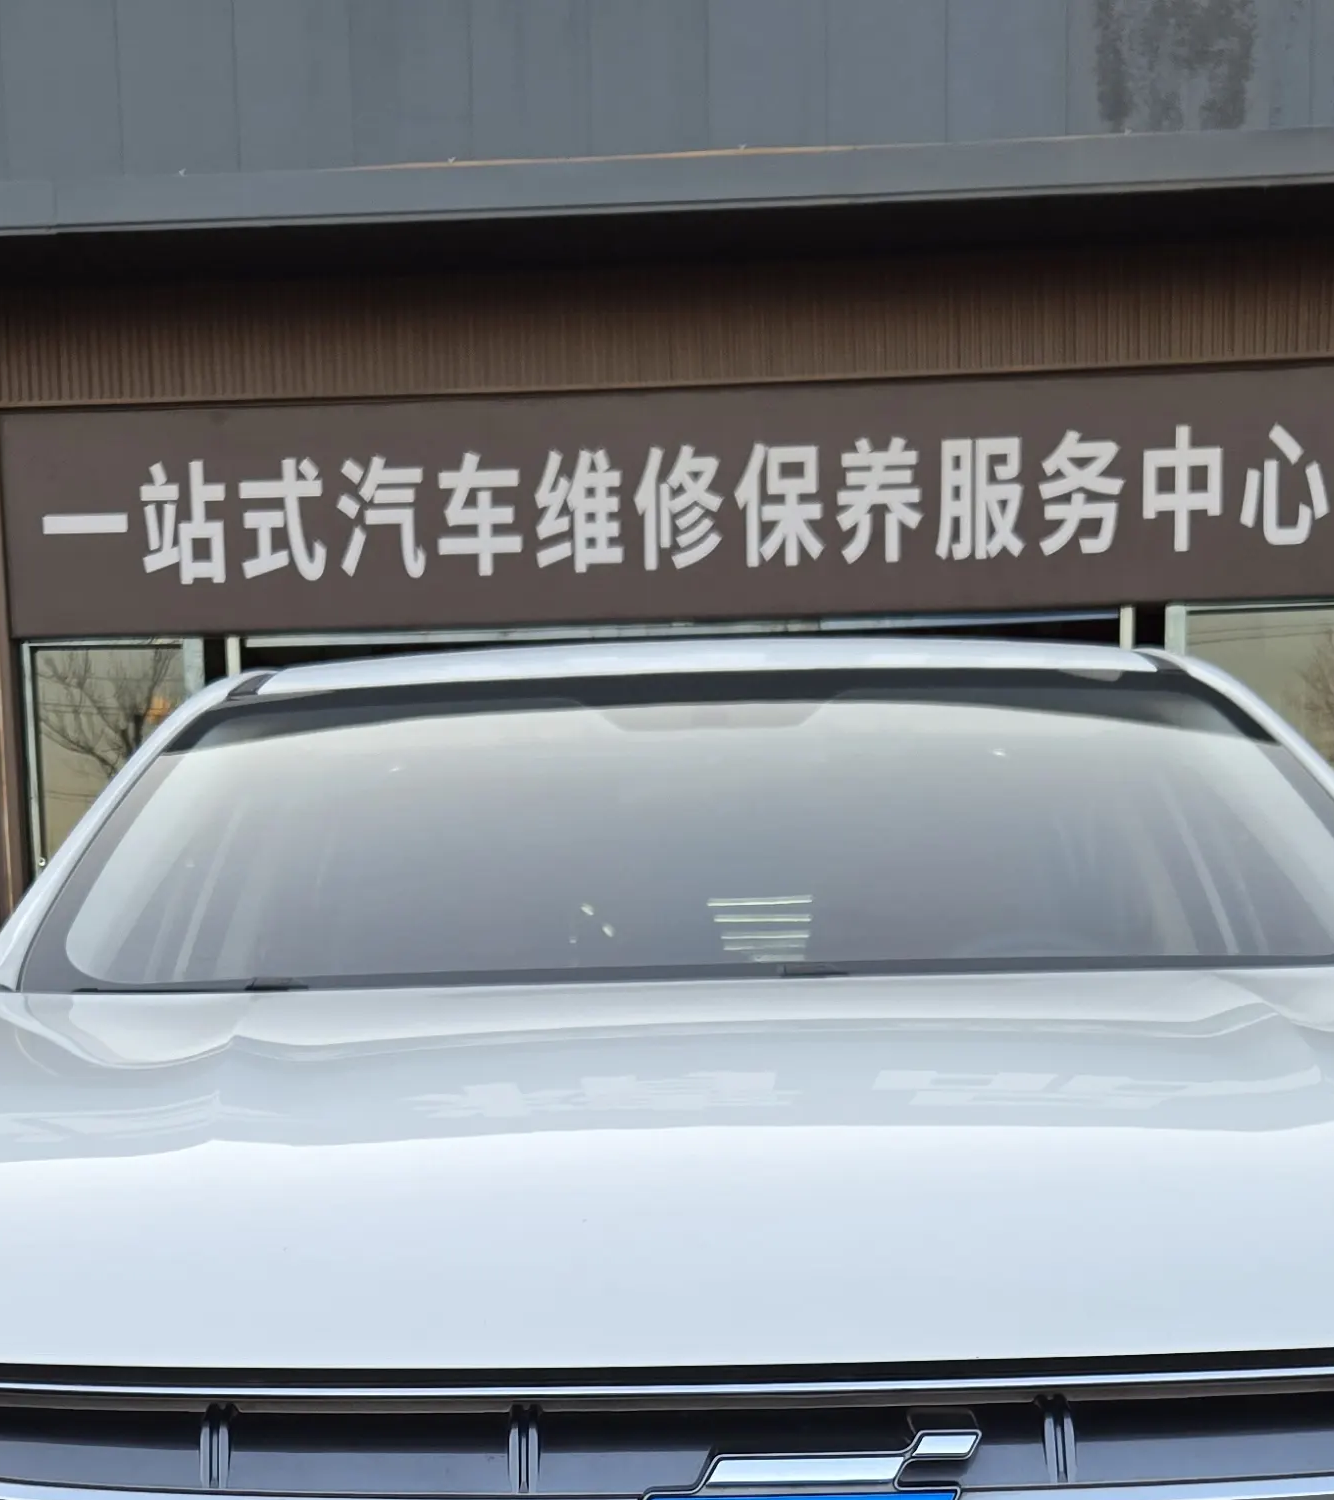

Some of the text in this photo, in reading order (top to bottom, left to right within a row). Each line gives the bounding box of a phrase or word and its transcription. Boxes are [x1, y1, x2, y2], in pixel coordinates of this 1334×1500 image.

[41, 423, 1330, 586] 一站式汽车维修保养服务中心
